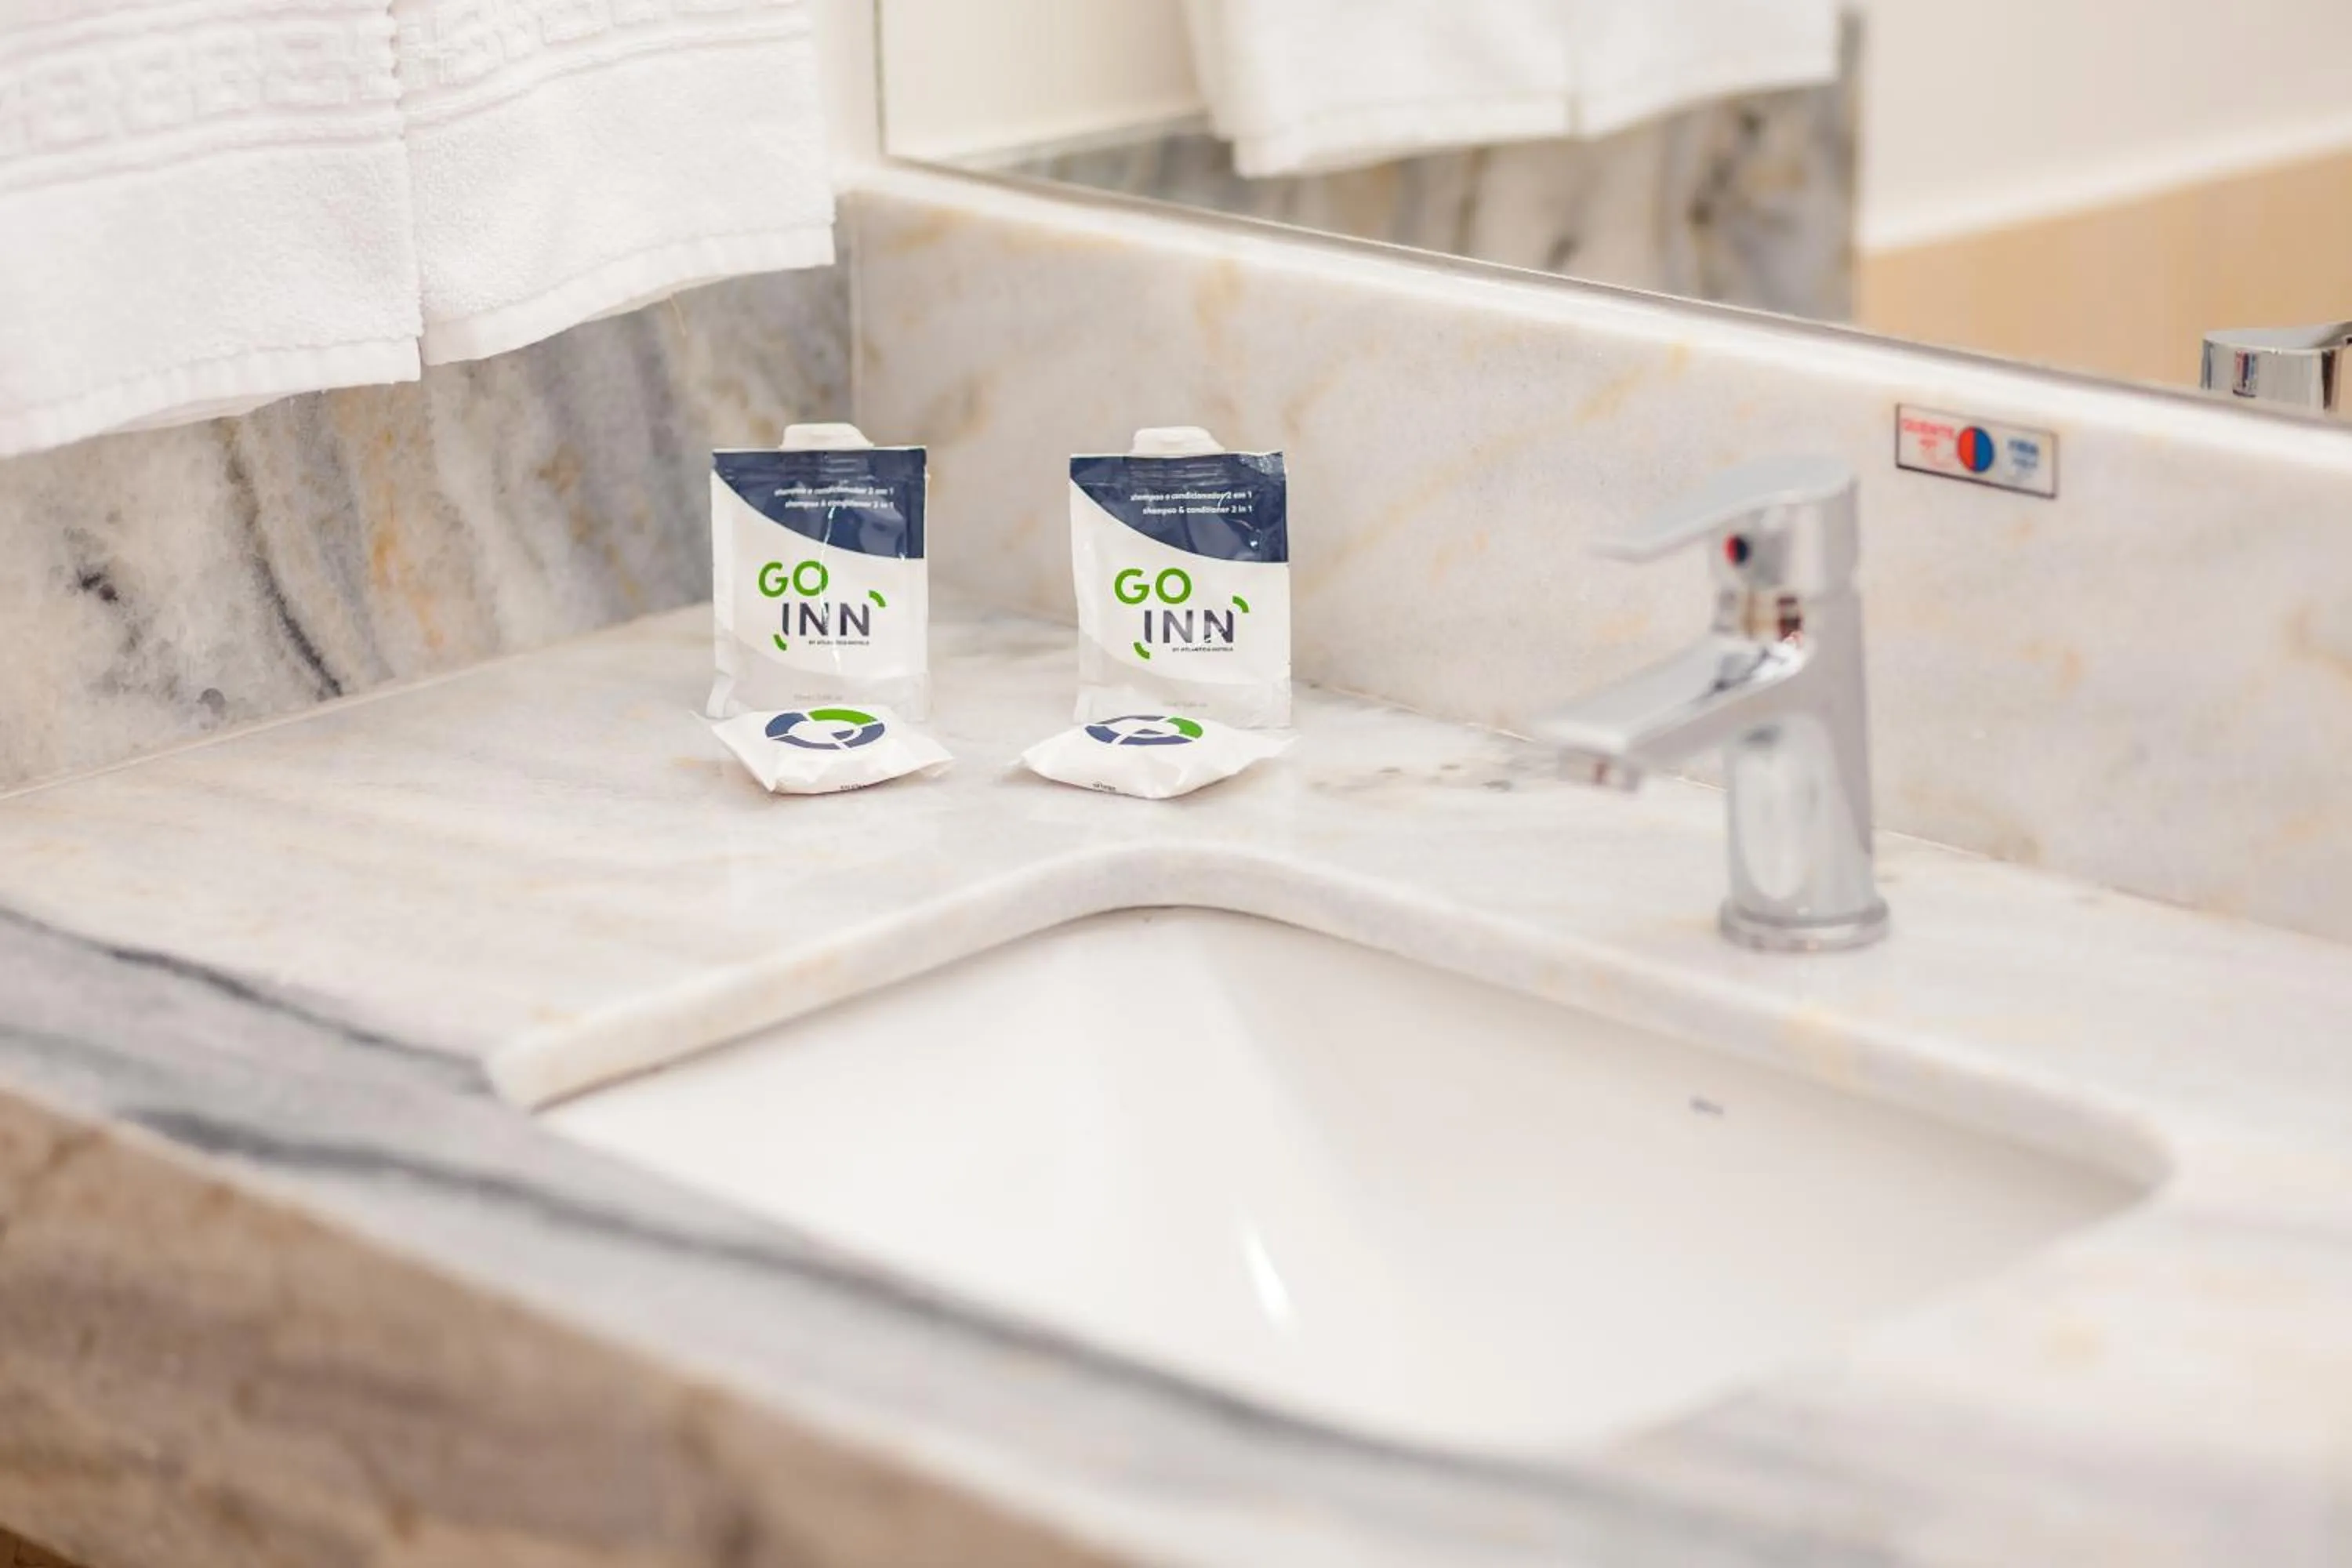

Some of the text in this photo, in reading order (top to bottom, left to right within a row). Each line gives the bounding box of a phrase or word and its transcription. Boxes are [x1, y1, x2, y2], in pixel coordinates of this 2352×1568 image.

[872, 500, 879, 509] 2
[1142, 506, 1177, 516] shampoo
[1178, 506, 1185, 514] &
[1186, 506, 1230, 514] conditioner
[1238, 505, 1247, 514] in
[758, 560, 829, 597] GO
[1114, 567, 1192, 604] GO
[782, 601, 870, 637] INN
[1144, 609, 1234, 644] INN
